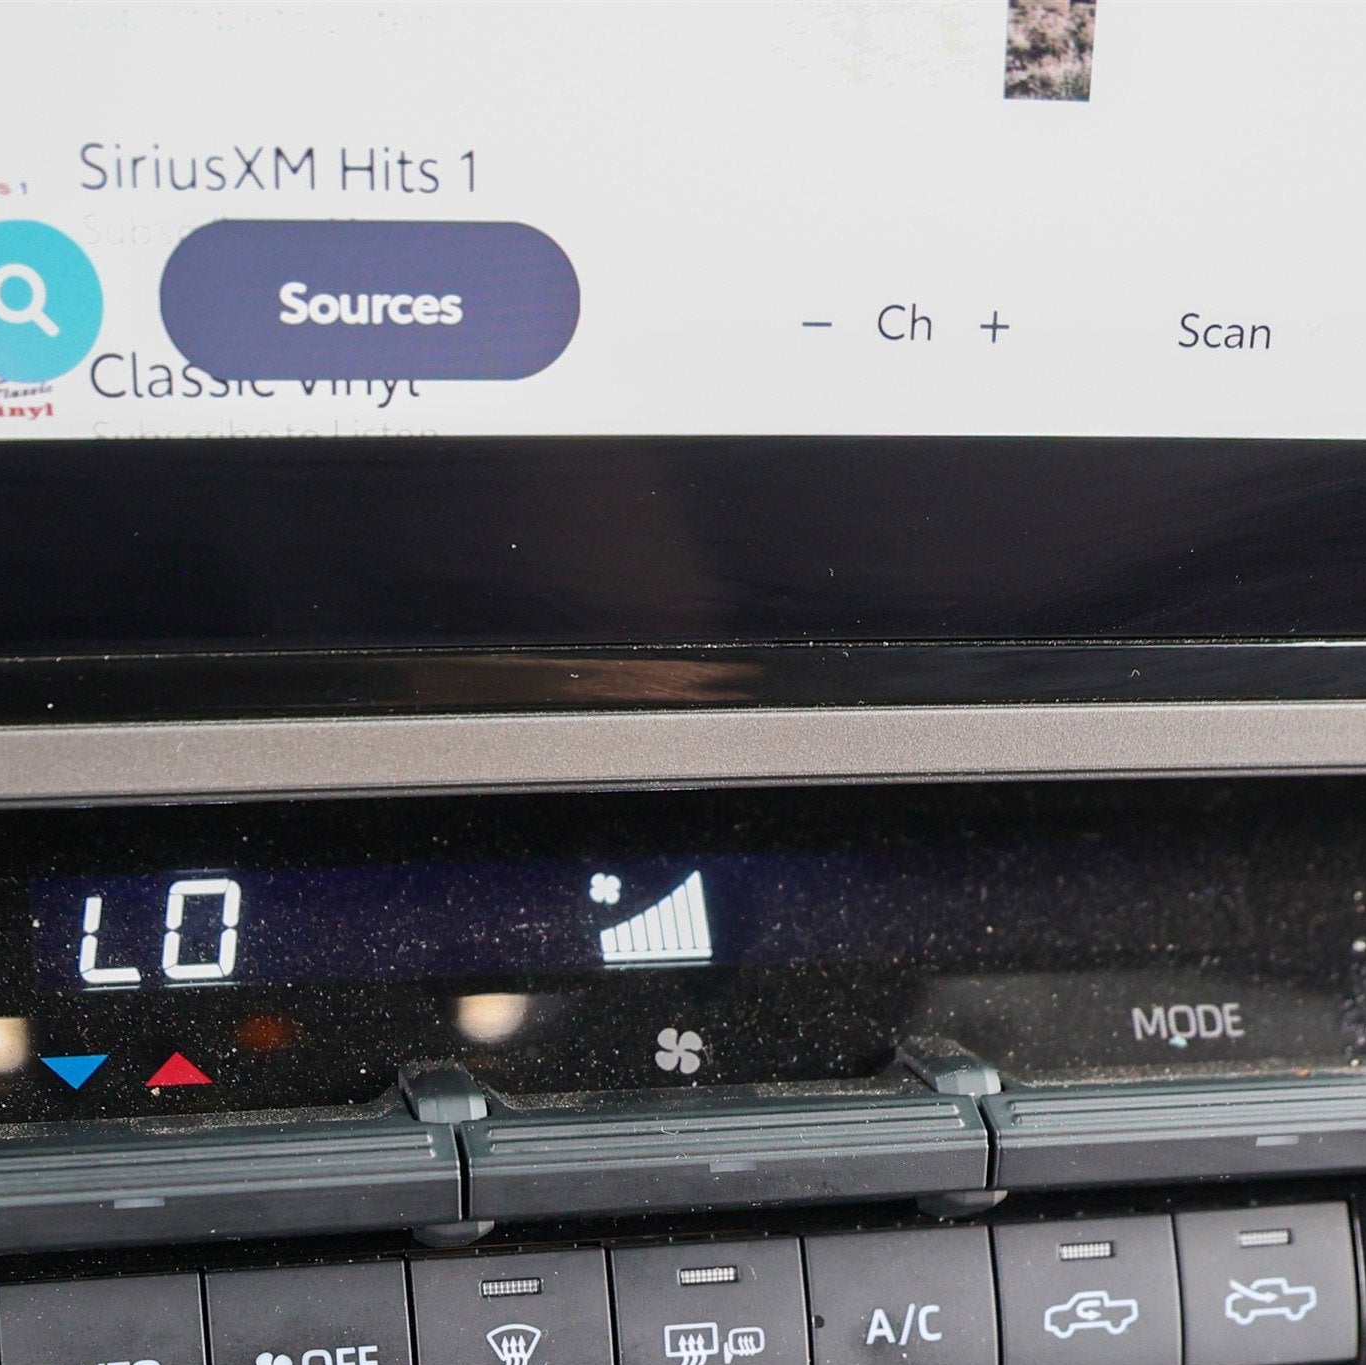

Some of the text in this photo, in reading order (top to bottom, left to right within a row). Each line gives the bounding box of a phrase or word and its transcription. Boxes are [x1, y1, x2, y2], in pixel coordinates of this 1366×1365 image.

[80, 143, 476, 194] SiriusXM Hits 1
[278, 281, 464, 326] Sources
[877, 303, 933, 342] Ch
[1178, 312, 1272, 350] Scan
[1131, 1003, 1245, 1042] MODE
[865, 1304, 943, 1346] A/C
